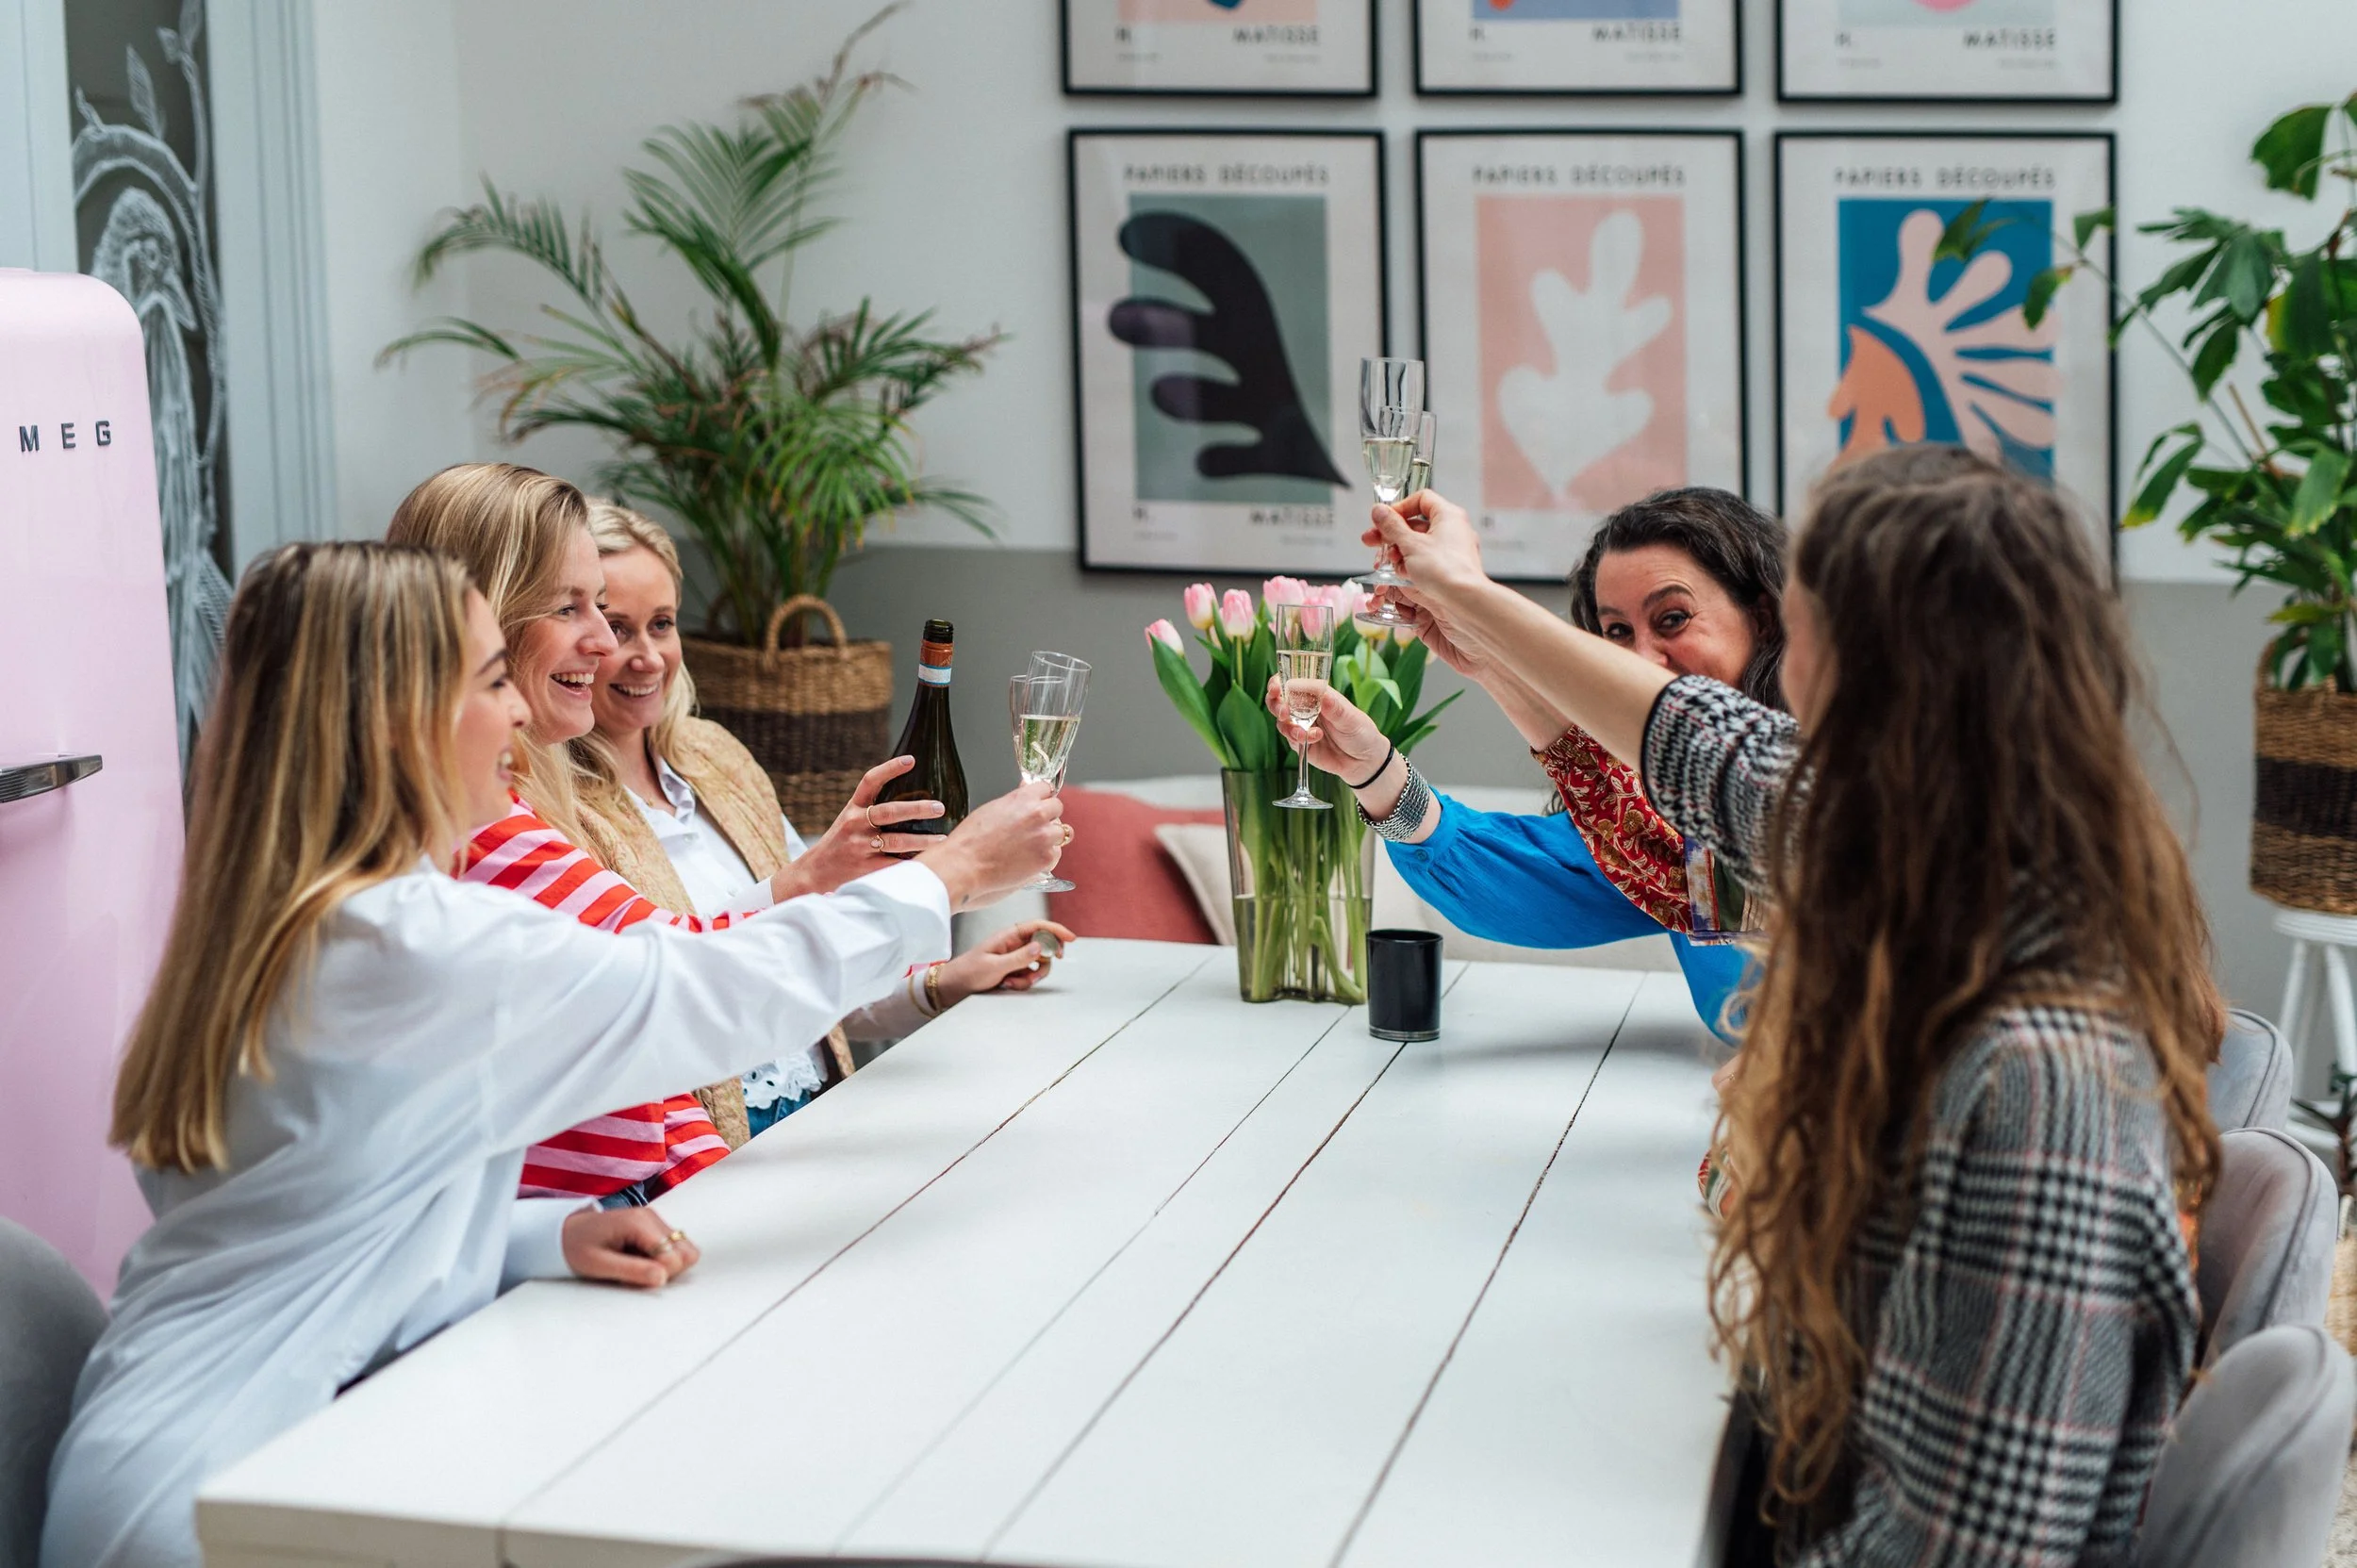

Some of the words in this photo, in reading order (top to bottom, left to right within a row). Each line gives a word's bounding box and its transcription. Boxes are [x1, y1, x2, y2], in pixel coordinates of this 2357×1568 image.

[1232, 25, 1320, 44] MATISSE
[1591, 25, 1683, 42] MATISSE
[1963, 29, 2057, 48] MATISSE
[1124, 164, 1206, 184] PAPIERS
[1473, 165, 1558, 185] PAPIERS
[1835, 168, 1922, 188] PAPIERS
[19, 421, 111, 453] MEG
